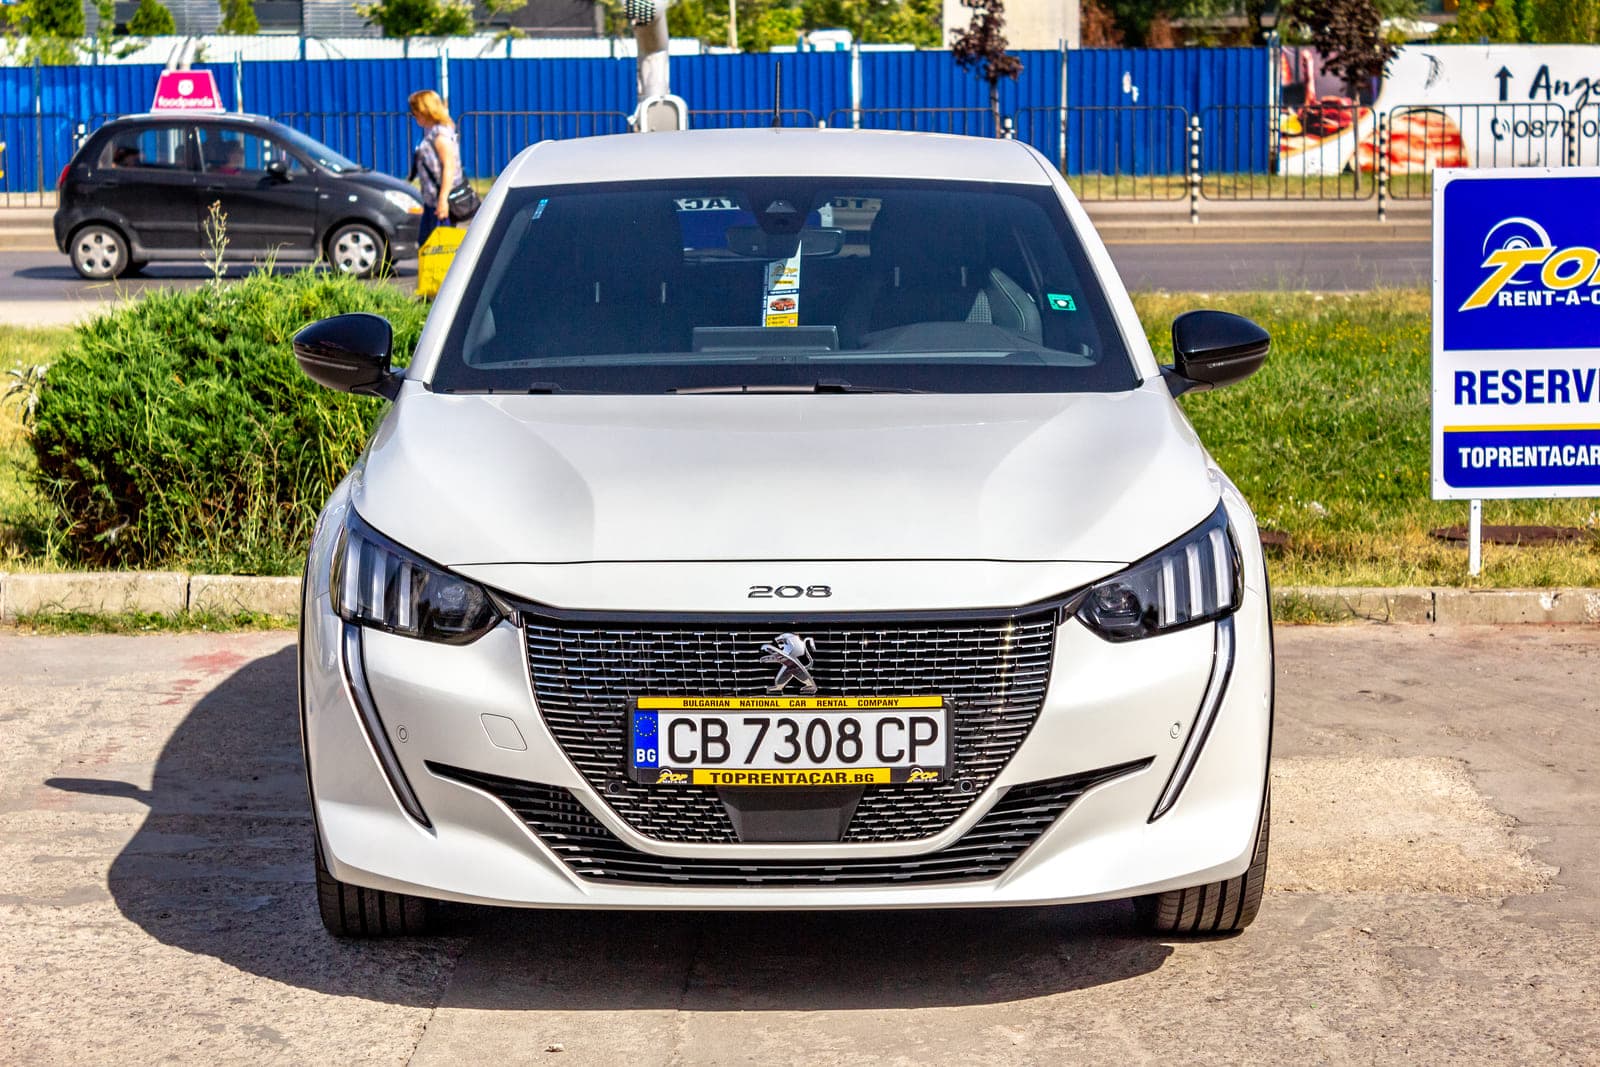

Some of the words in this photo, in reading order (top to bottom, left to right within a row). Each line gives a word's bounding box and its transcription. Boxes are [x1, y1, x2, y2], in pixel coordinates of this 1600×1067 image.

[158, 96, 213, 109] foodpanda
[1458, 246, 1600, 312] TO
[1498, 289, 1600, 307] RENT-A-C
[1454, 367, 1600, 406] RESERV
[1459, 445, 1600, 468] TOPRENTACAR
[748, 585, 832, 598] 208
[683, 699, 730, 707] BULGARIAN
[740, 699, 780, 707] NATIONAL
[789, 699, 807, 707] CAR
[816, 699, 848, 707] RENTAL
[857, 699, 900, 707] COMPANY
[667, 717, 731, 764] CB
[743, 717, 863, 764] 7308
[875, 716, 939, 763] CP
[636, 749, 656, 763] BG
[710, 772, 875, 784] TOPRENTACAR.BG
